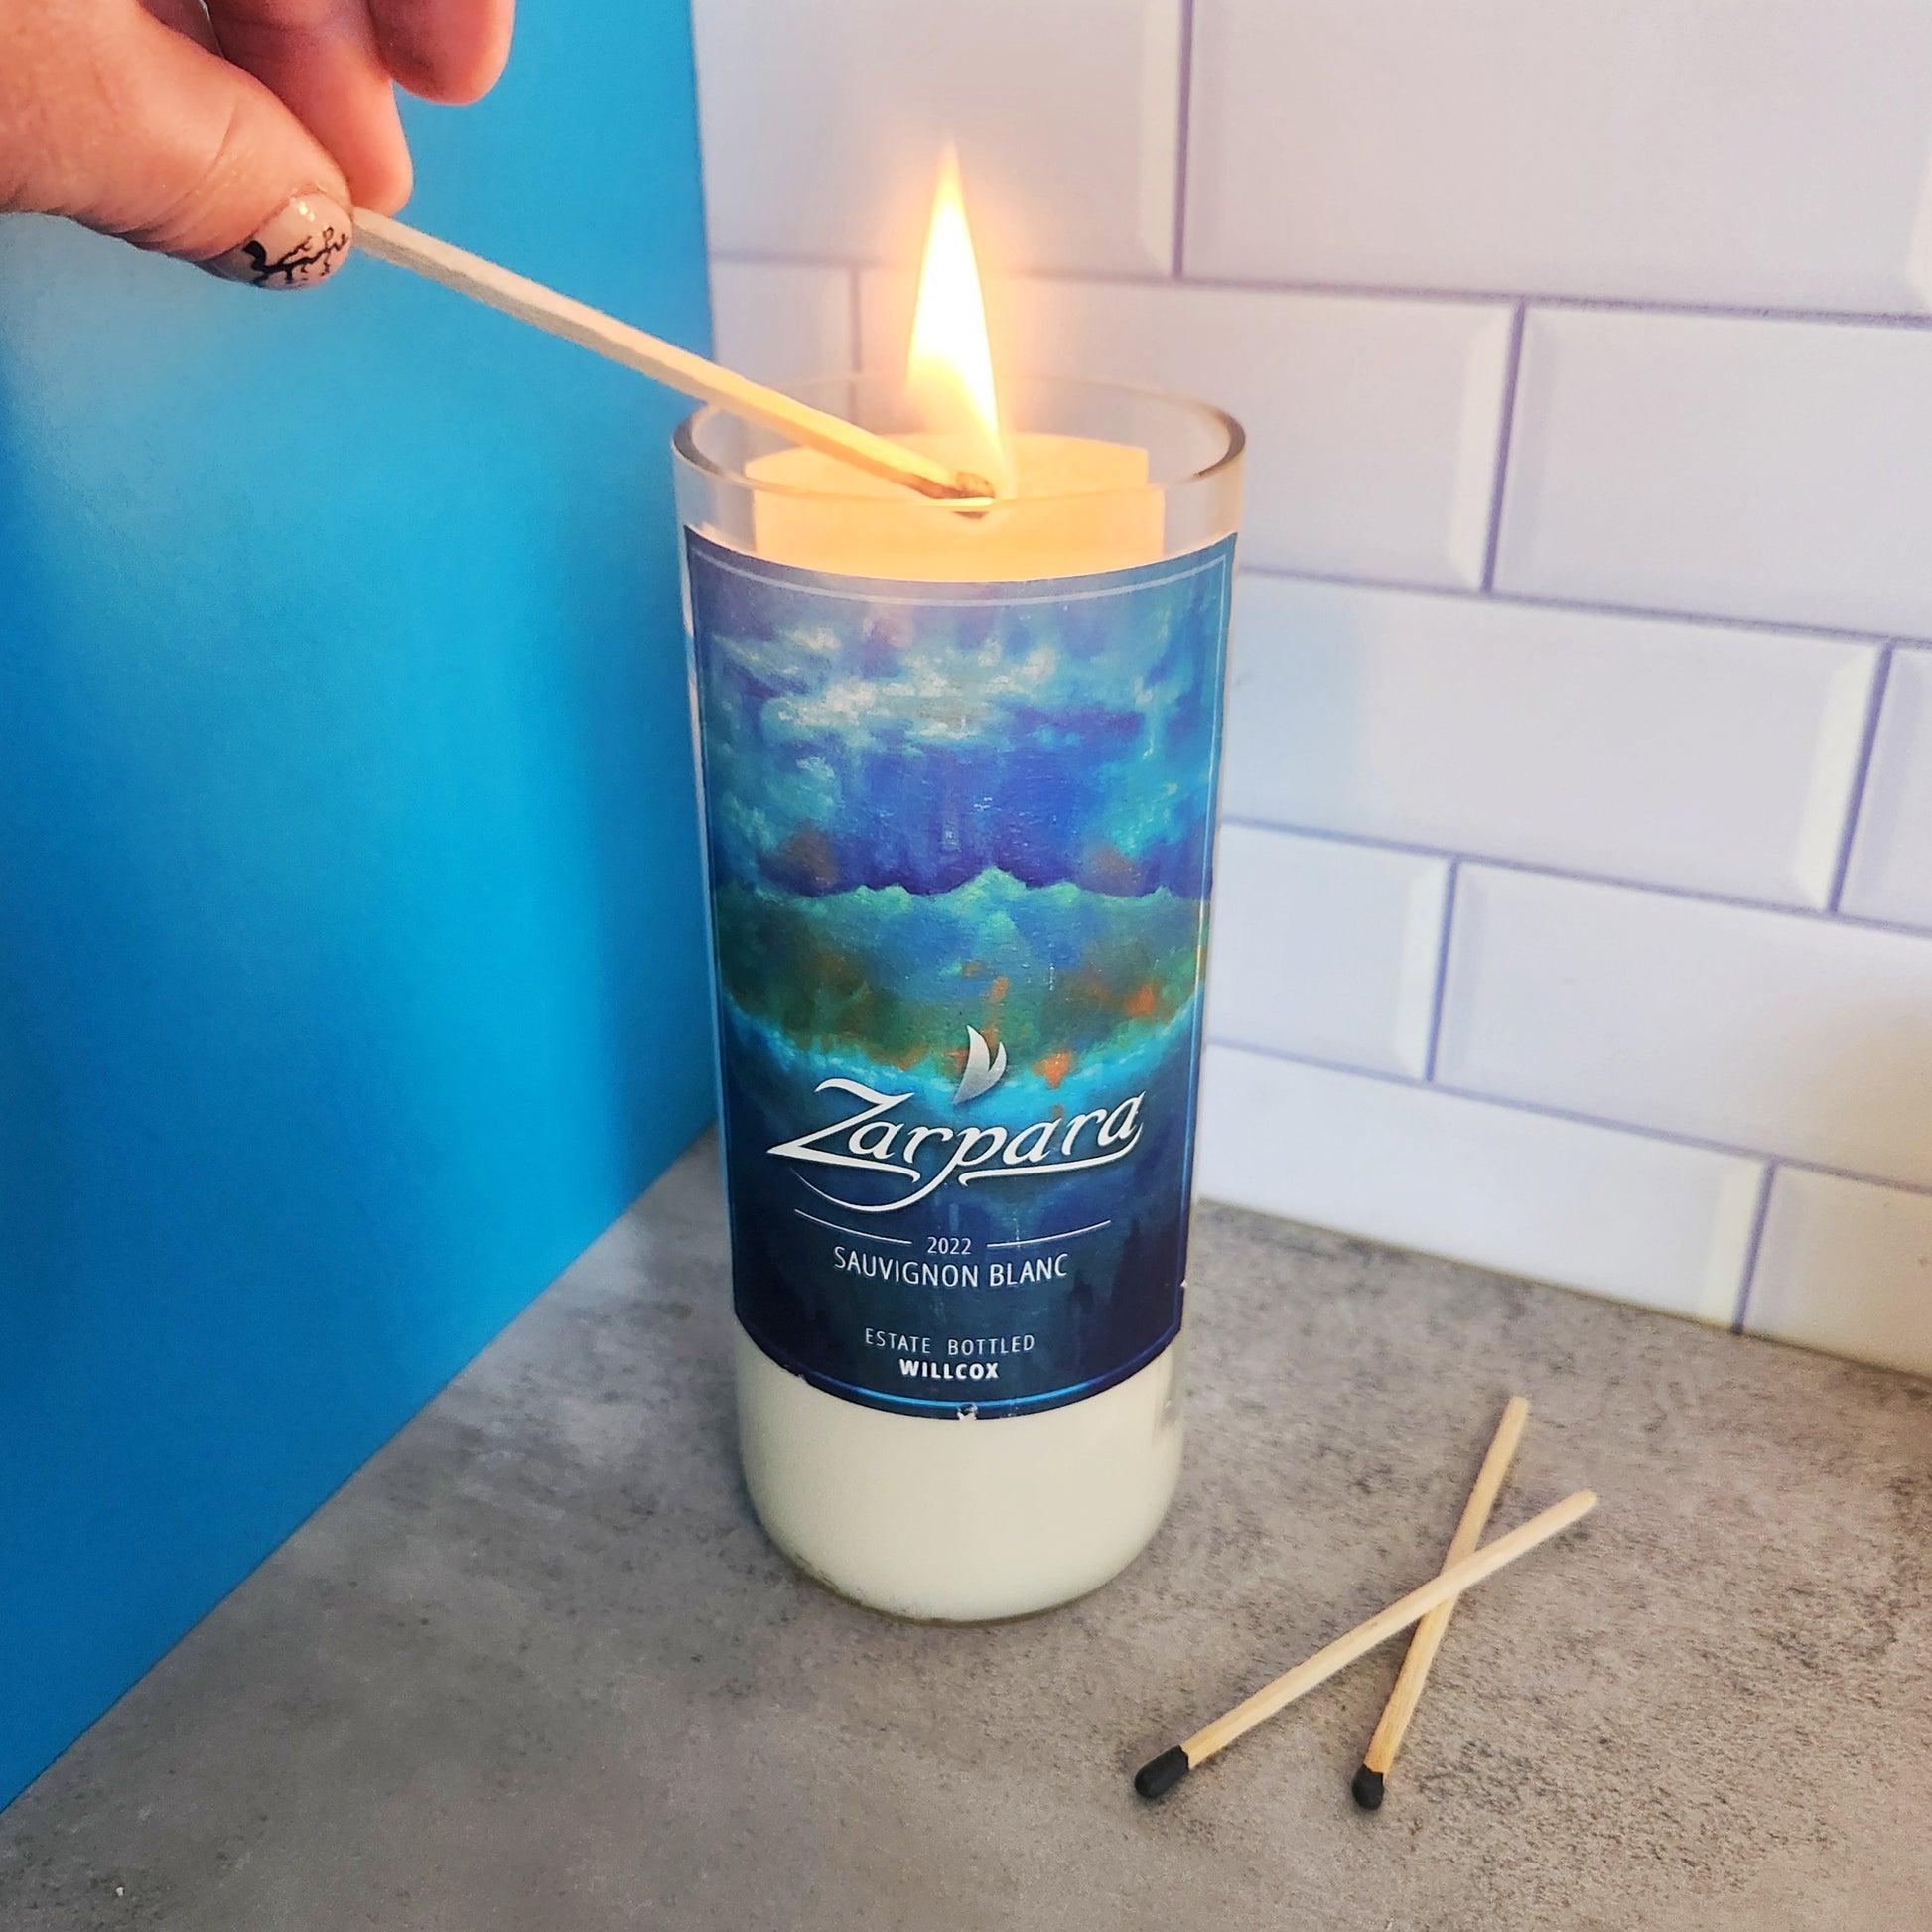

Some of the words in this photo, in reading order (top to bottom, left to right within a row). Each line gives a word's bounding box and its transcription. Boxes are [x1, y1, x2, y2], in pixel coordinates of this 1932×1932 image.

[766, 1078, 1146, 1213] Zarpara
[926, 1236, 973, 1256] 2022
[833, 1245, 980, 1288] SAUVIGNON
[989, 1253, 1068, 1287] BLANC
[865, 1328, 932, 1354] ESTATE
[947, 1334, 1035, 1356] BOTTLED
[899, 1359, 1000, 1380] WILLCOX
